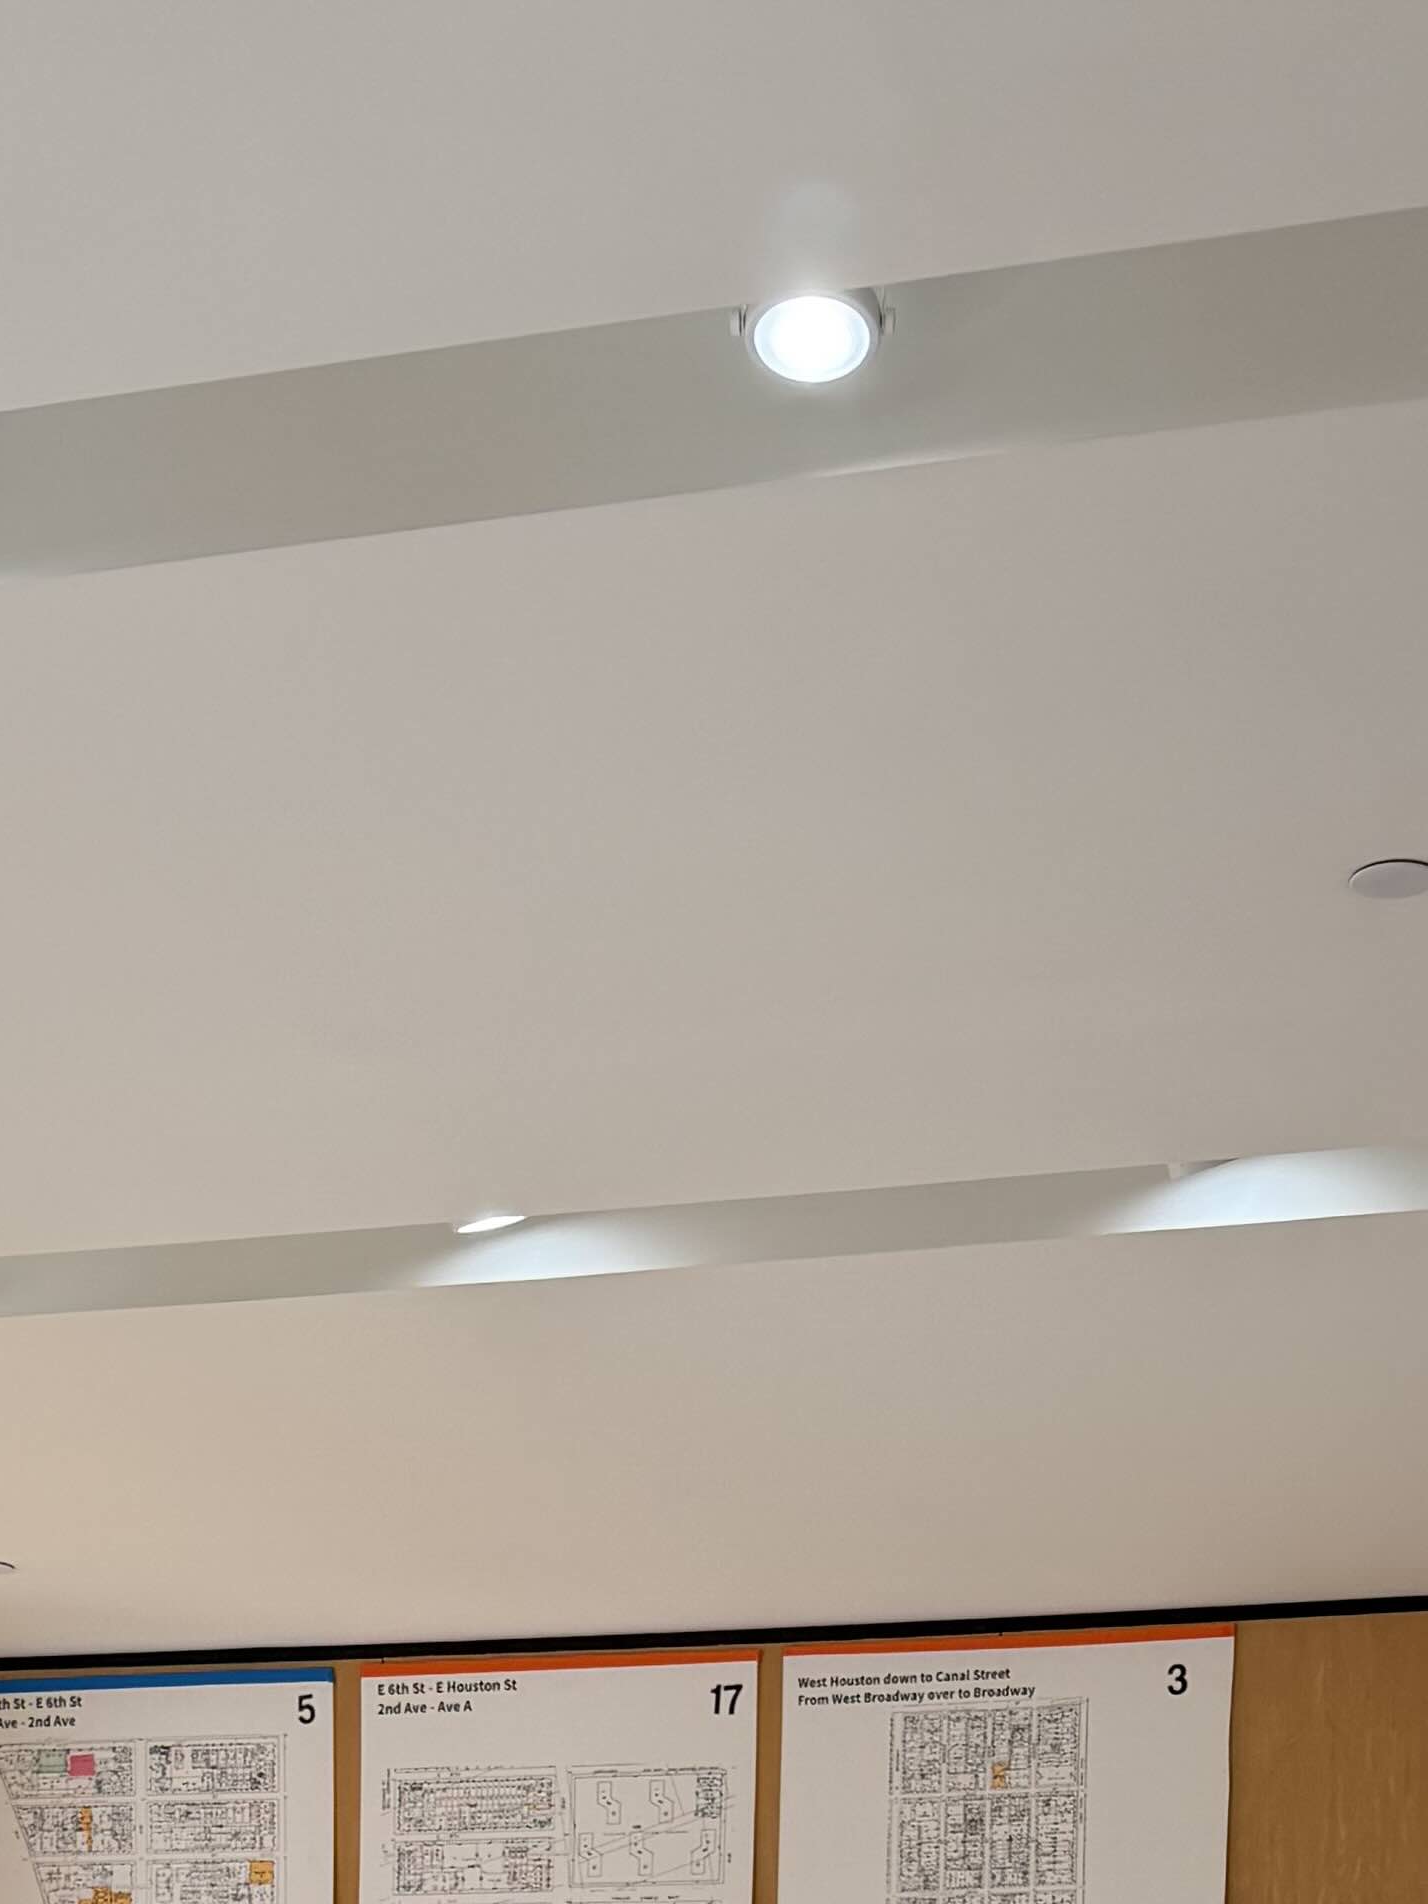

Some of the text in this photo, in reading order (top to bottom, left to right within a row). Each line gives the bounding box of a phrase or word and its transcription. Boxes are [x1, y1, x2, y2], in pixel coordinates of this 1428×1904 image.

[377, 1678, 517, 1696] E 6th St E Houston St
[798, 1667, 1010, 1689] West Houston down to Canal Street
[1167, 1664, 1188, 1695] 3
[13, 1698, 25, 1711] St
[36, 1698, 43, 1710] E
[46, 1696, 66, 1709] 6th
[69, 1696, 82, 1709] St
[710, 1684, 743, 1716] 17
[798, 1684, 1036, 1706] From West Broadway over to Broadway
[297, 1694, 316, 1725] 5
[377, 1700, 472, 1716] 2nd Ave Ave A
[28, 1716, 50, 1729] 2nd
[53, 1716, 75, 1728] Ave
